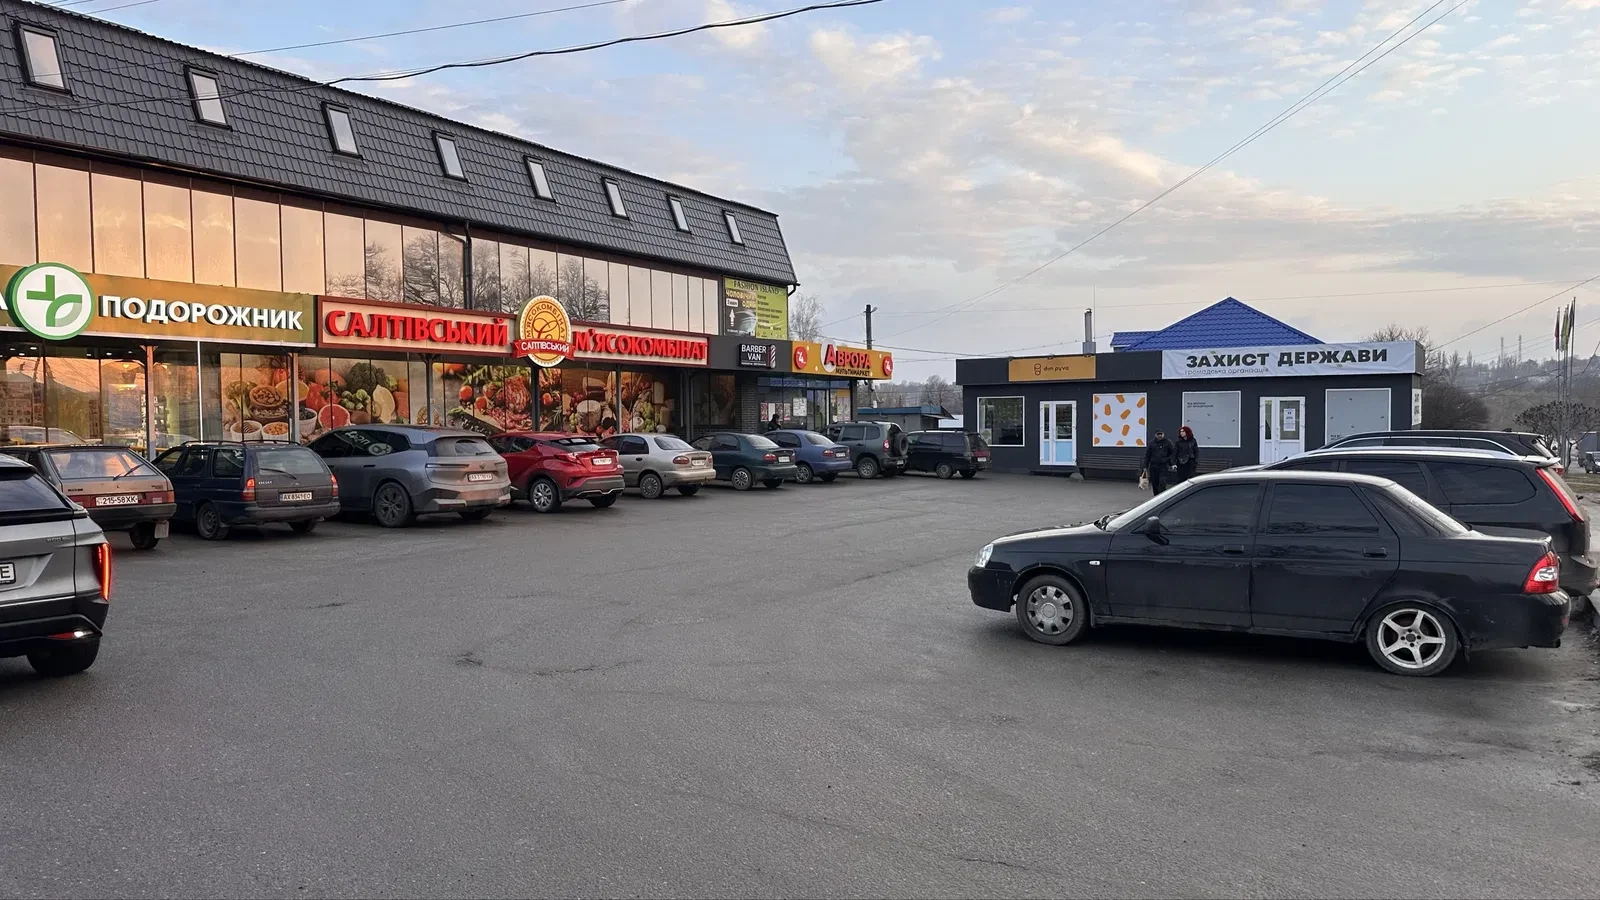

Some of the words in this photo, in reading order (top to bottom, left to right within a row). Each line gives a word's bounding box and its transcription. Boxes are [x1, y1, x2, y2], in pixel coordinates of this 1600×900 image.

[733, 280, 758, 291] FASHION
[760, 285, 780, 295] ISLAND
[100, 295, 303, 330] ПОДОРОЖНИК
[326, 310, 508, 346] САЛТІВСЬКИЙ
[521, 341, 569, 352] САЛТІВСЬКИЙ
[574, 328, 708, 360] М'ЯСОКОМБІНАТ
[741, 344, 767, 353] BARBER
[747, 352, 762, 361] VAN
[824, 344, 871, 369] АВРОРА
[1186, 353, 1270, 368] ЗАХИСТ
[1277, 349, 1388, 367] ДЕРЖАВИ
[835, 367, 870, 377] МУЛЬТИМАРКЕТ
